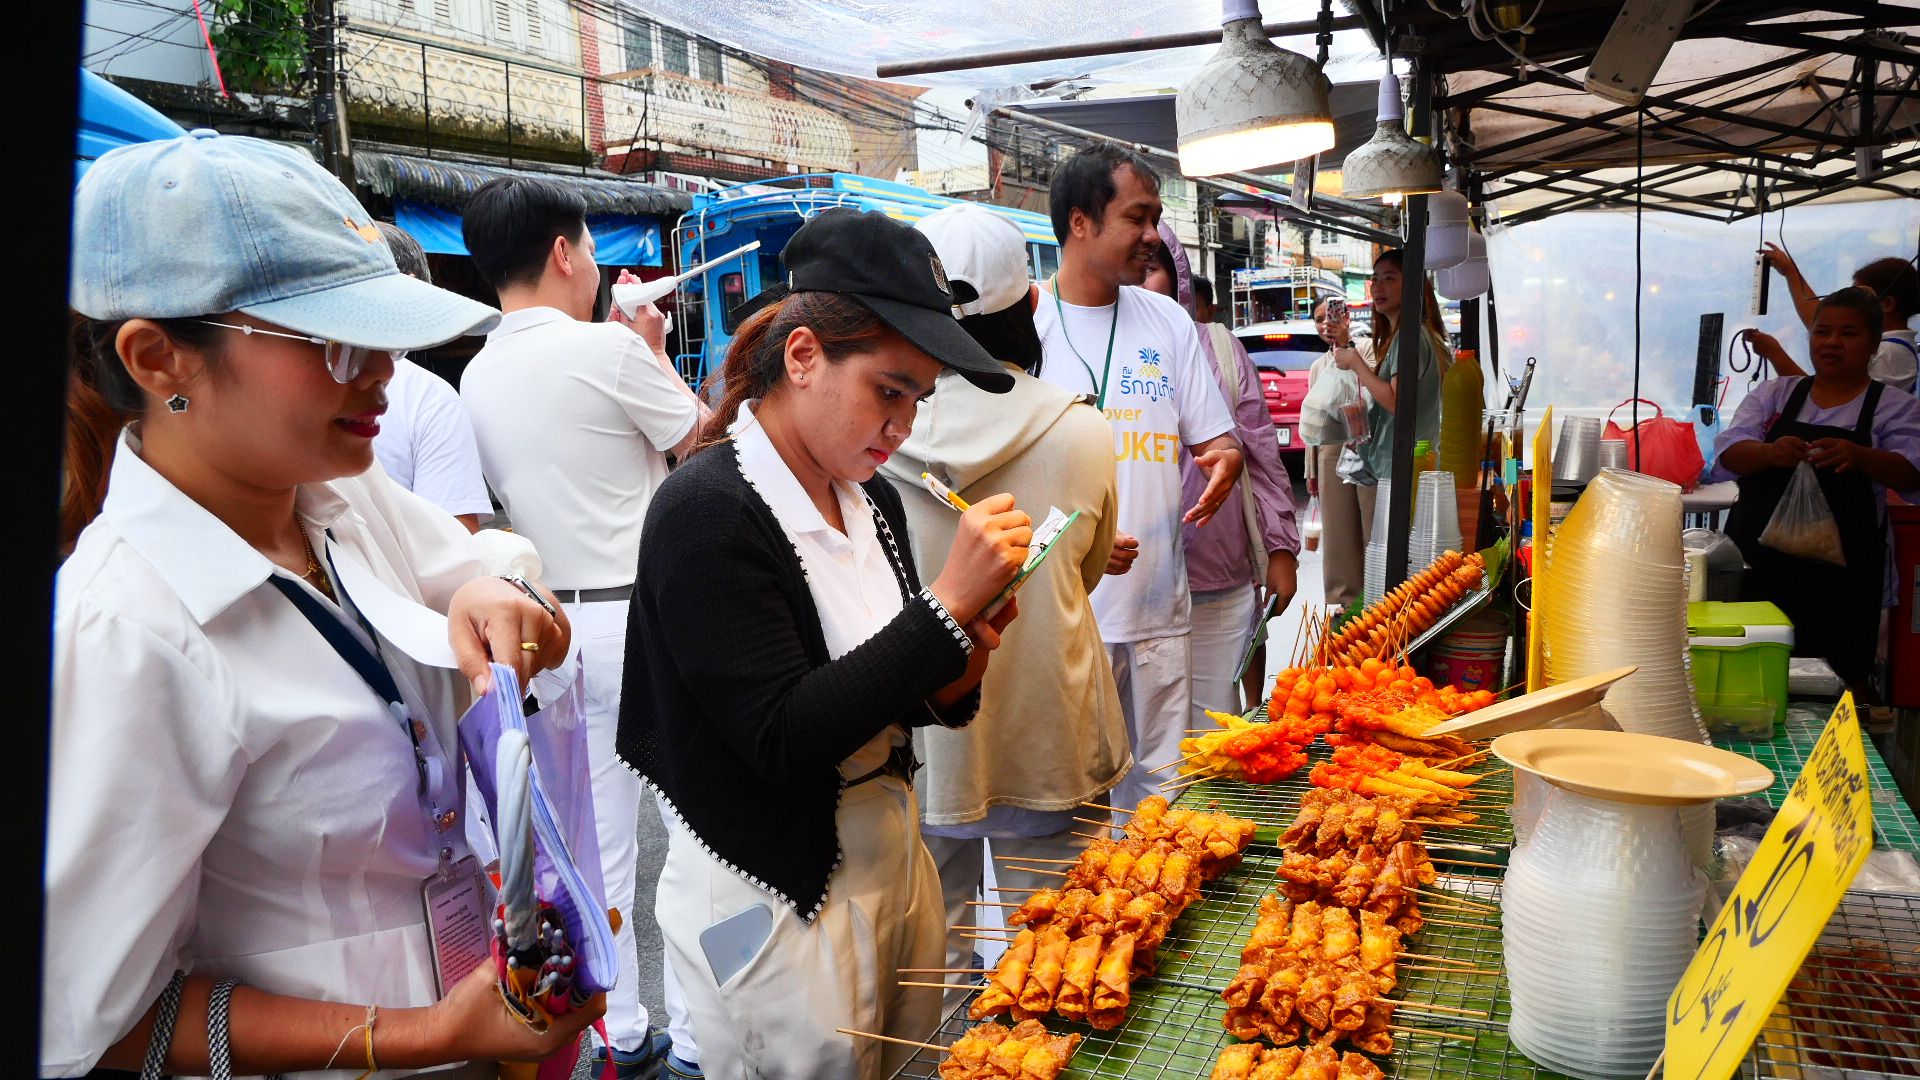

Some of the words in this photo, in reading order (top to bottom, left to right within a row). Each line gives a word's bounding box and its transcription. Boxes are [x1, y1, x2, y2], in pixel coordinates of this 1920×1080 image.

[1103, 408, 1143, 421] over
[1113, 431, 1180, 465] UKET
[1745, 806, 1815, 948] 10
